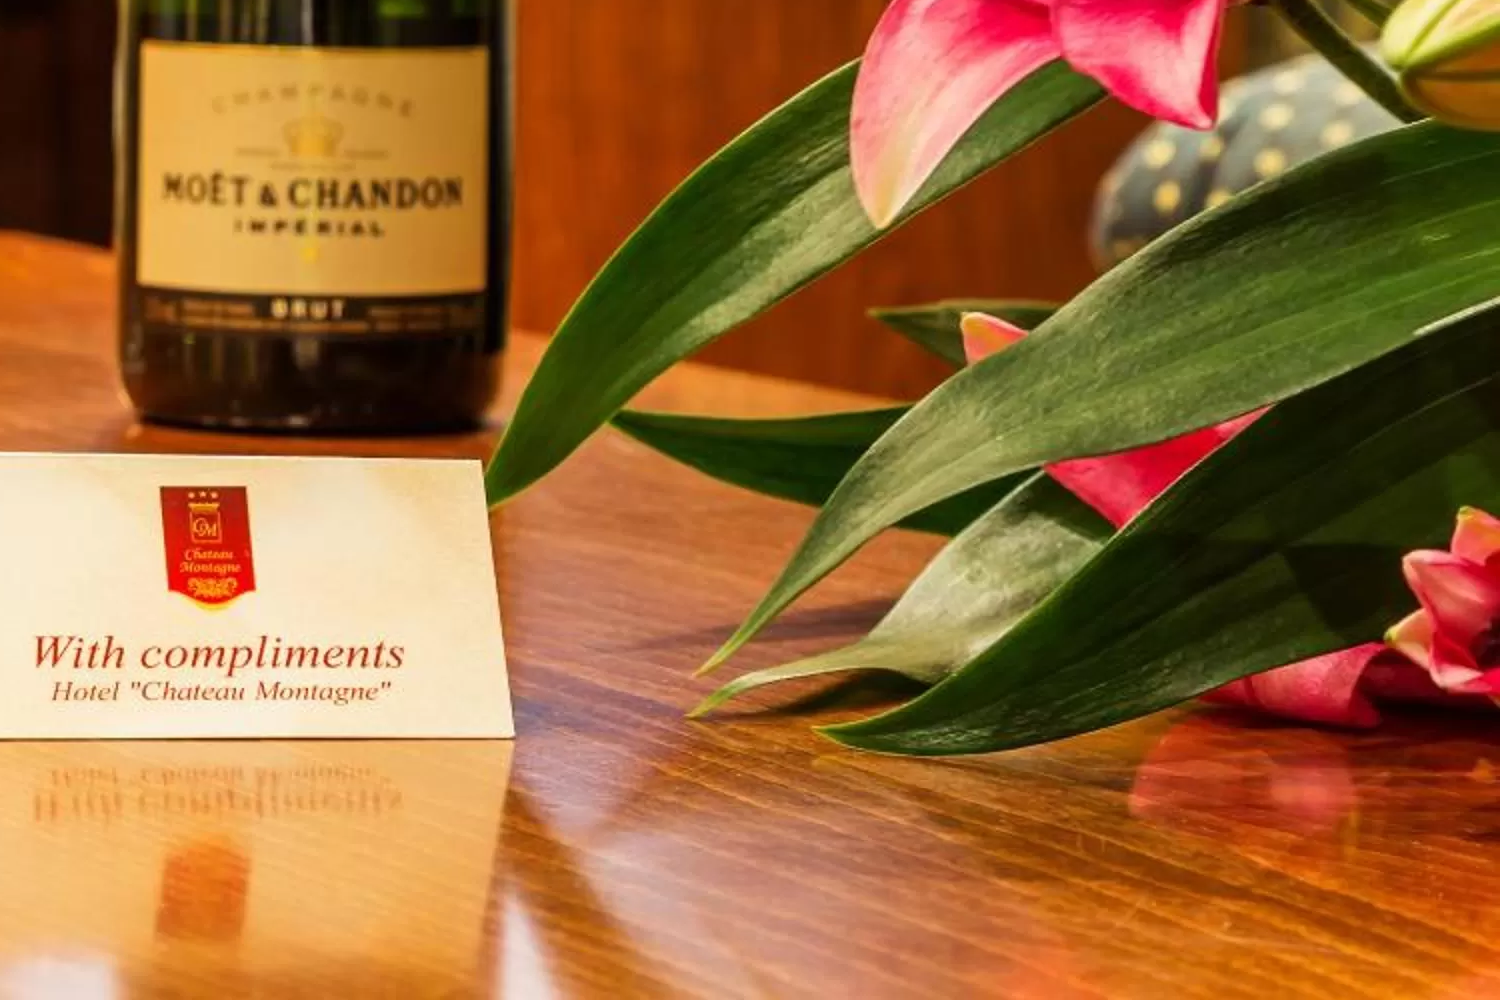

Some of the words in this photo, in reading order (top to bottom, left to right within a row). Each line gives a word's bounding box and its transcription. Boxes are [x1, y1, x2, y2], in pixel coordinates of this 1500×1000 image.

[211, 81, 414, 119] CHAMPAGNE
[258, 183, 278, 208] &
[287, 176, 464, 210] CHANDON
[270, 297, 345, 321] BRUT
[184, 546, 234, 561] Chateau
[179, 561, 242, 576] Montagne
[34, 634, 126, 670] With
[140, 634, 406, 678] compliments
[51, 680, 121, 702] Hotel
[130, 680, 246, 702] "Chateau
[255, 679, 392, 706] Montagne"
